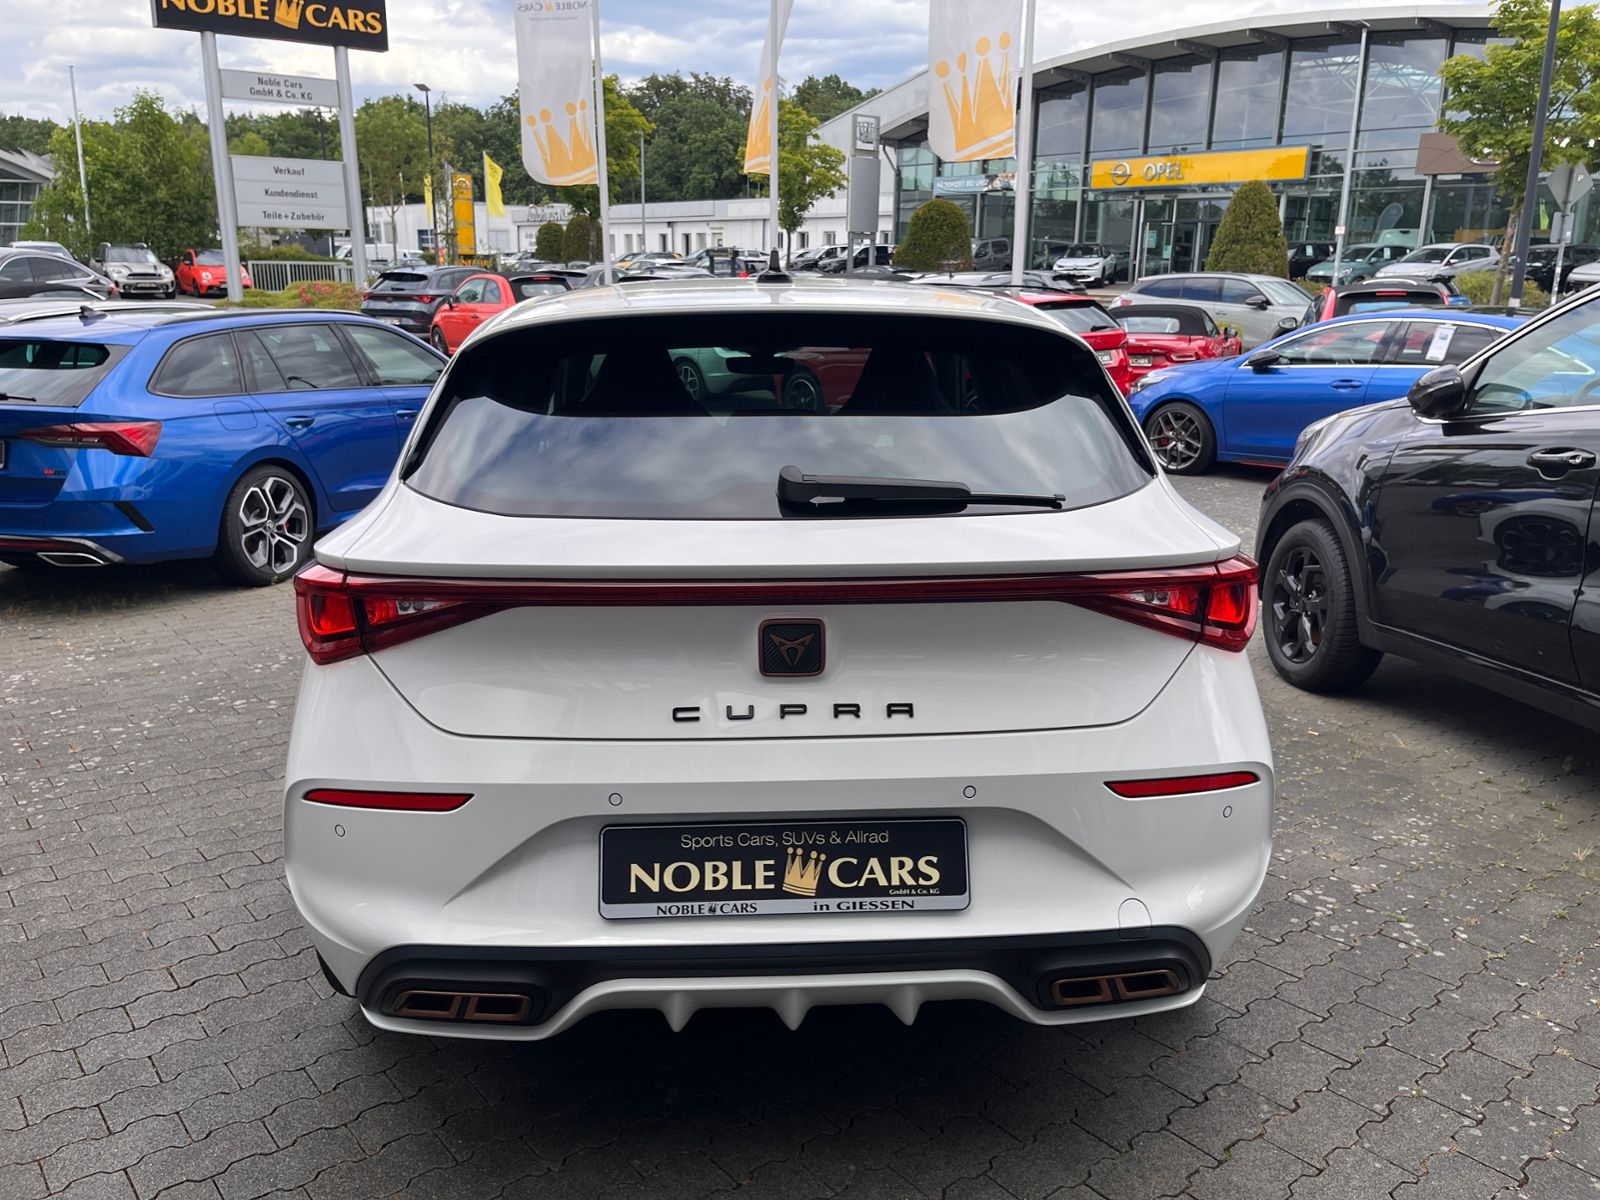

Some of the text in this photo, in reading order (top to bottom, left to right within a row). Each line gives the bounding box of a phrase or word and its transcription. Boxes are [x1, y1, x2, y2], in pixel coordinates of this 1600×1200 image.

[305, 4, 383, 34] CARS
[257, 77, 303, 89] Noble Cars
[249, 87, 313, 100] GmbH & Co. KG
[273, 166, 305, 176] Verkauf
[1144, 161, 1185, 182] OPEL
[264, 188, 318, 199] Kundendienst
[672, 703, 914, 722] CUPRA
[680, 830, 889, 851] Sports Cars, SUVs & Allrad
[629, 855, 941, 893] NOBLE CARS
[656, 902, 758, 916] NOBLE CARS
[814, 900, 915, 911] in GIESSEN
